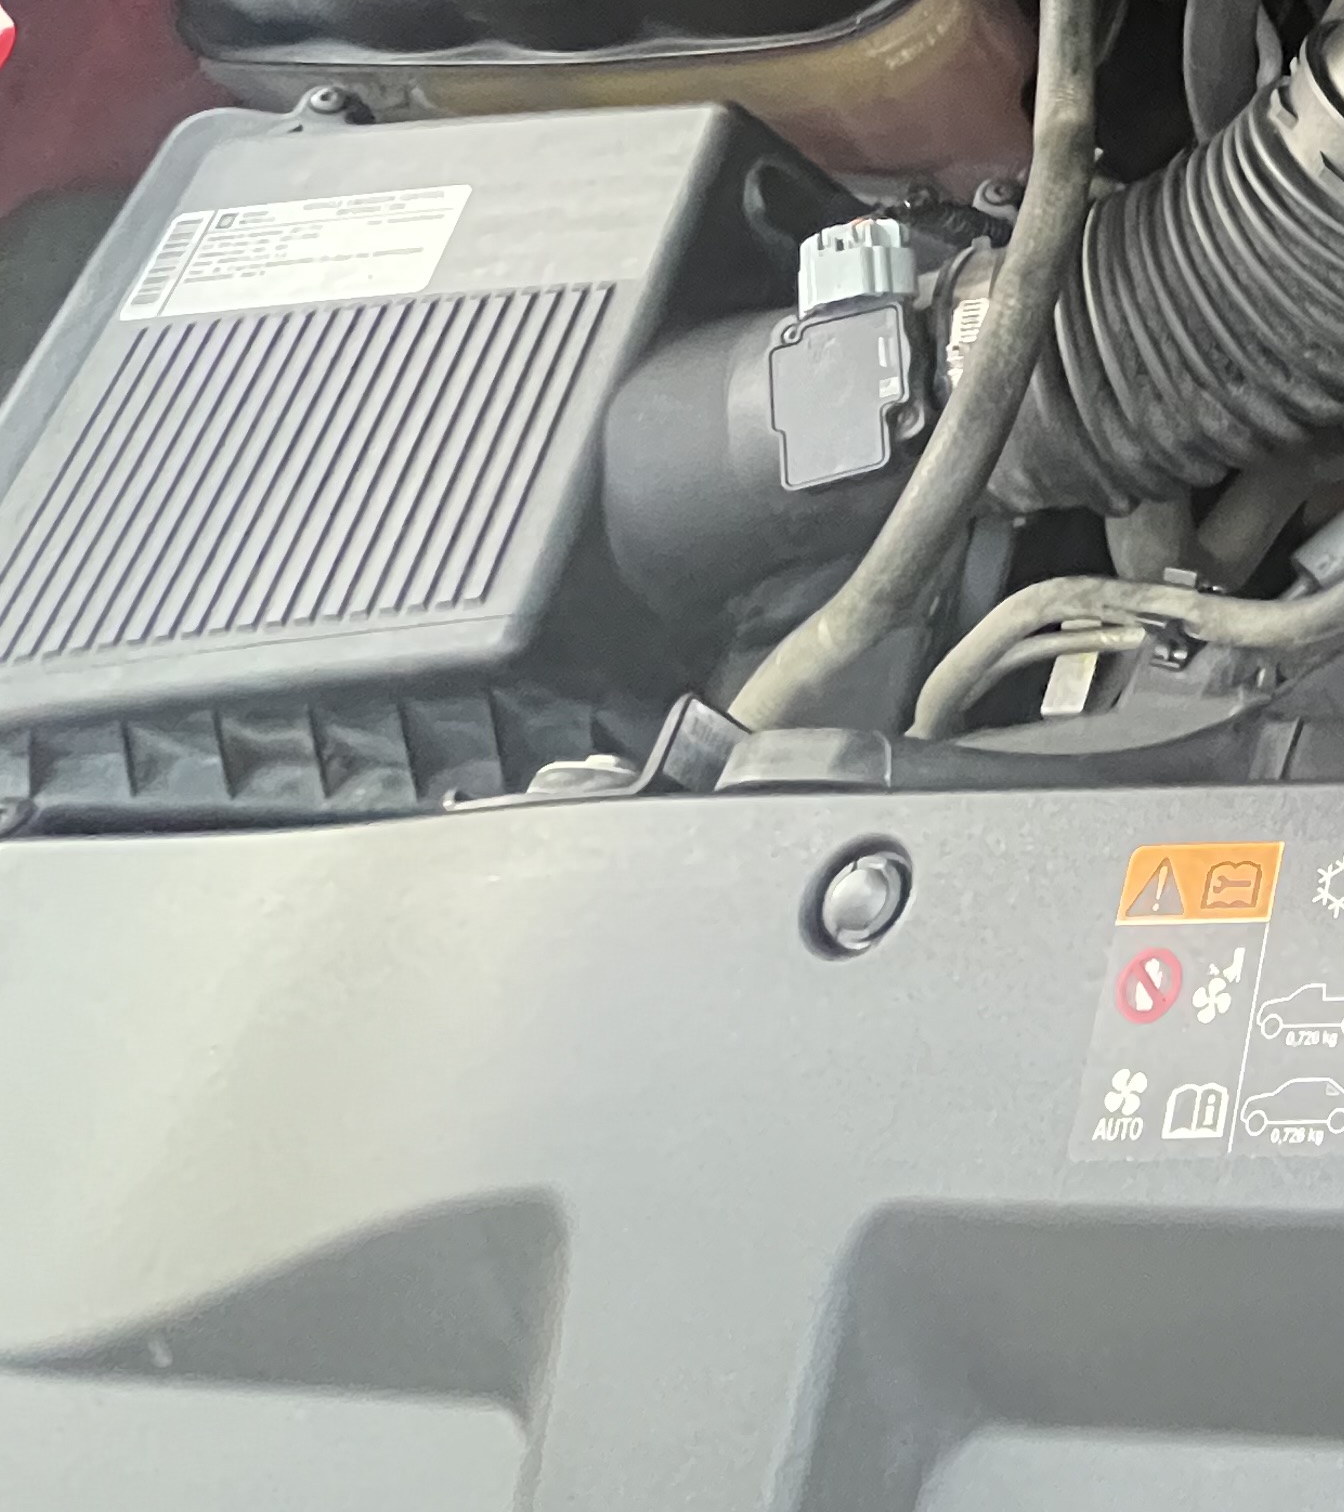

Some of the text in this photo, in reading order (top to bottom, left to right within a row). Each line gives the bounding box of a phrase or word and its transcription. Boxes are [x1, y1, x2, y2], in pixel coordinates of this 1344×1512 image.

[1323, 1030, 1337, 1047] kg
[1092, 1117, 1143, 1140] AUTO
[1308, 1127, 1323, 1145] kg
